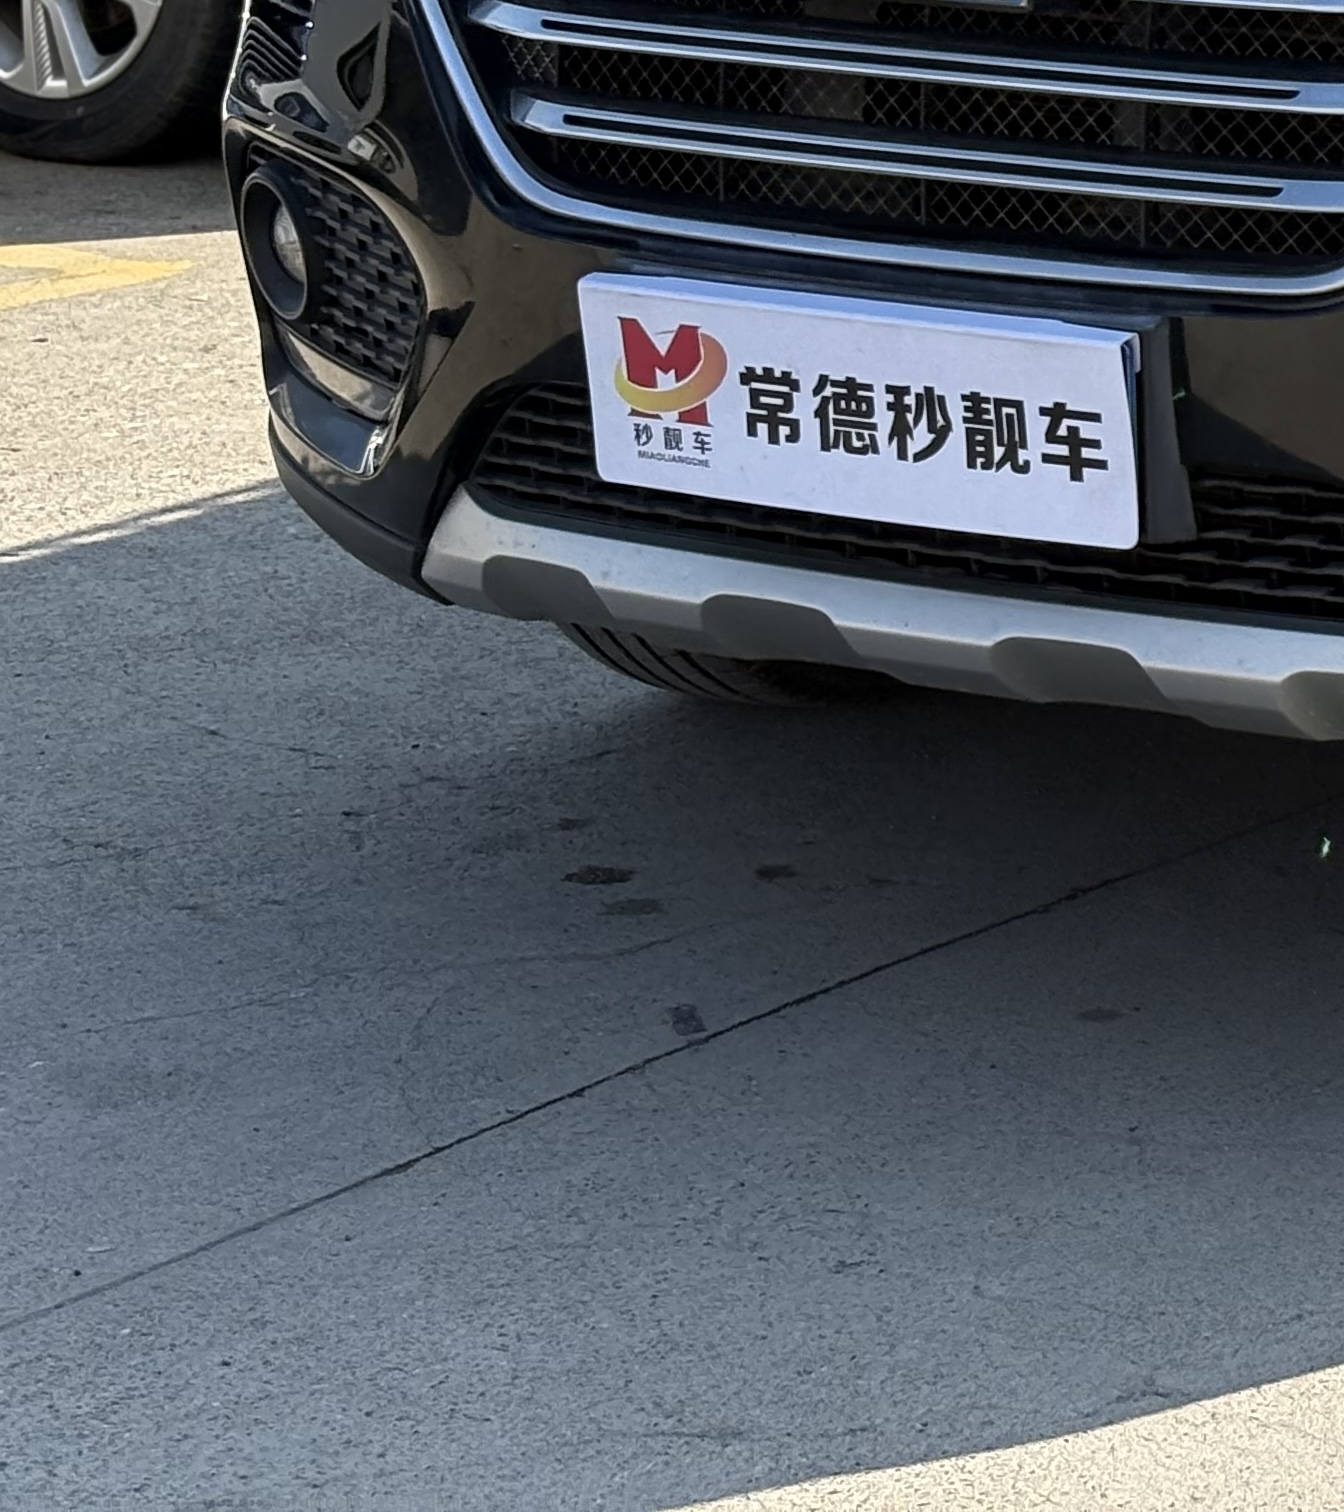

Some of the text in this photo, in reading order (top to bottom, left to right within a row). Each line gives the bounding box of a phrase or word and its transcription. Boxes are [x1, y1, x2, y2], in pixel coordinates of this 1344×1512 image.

[633, 422, 713, 455] 秒靓车
[738, 365, 1110, 483] 常德秒靓车
